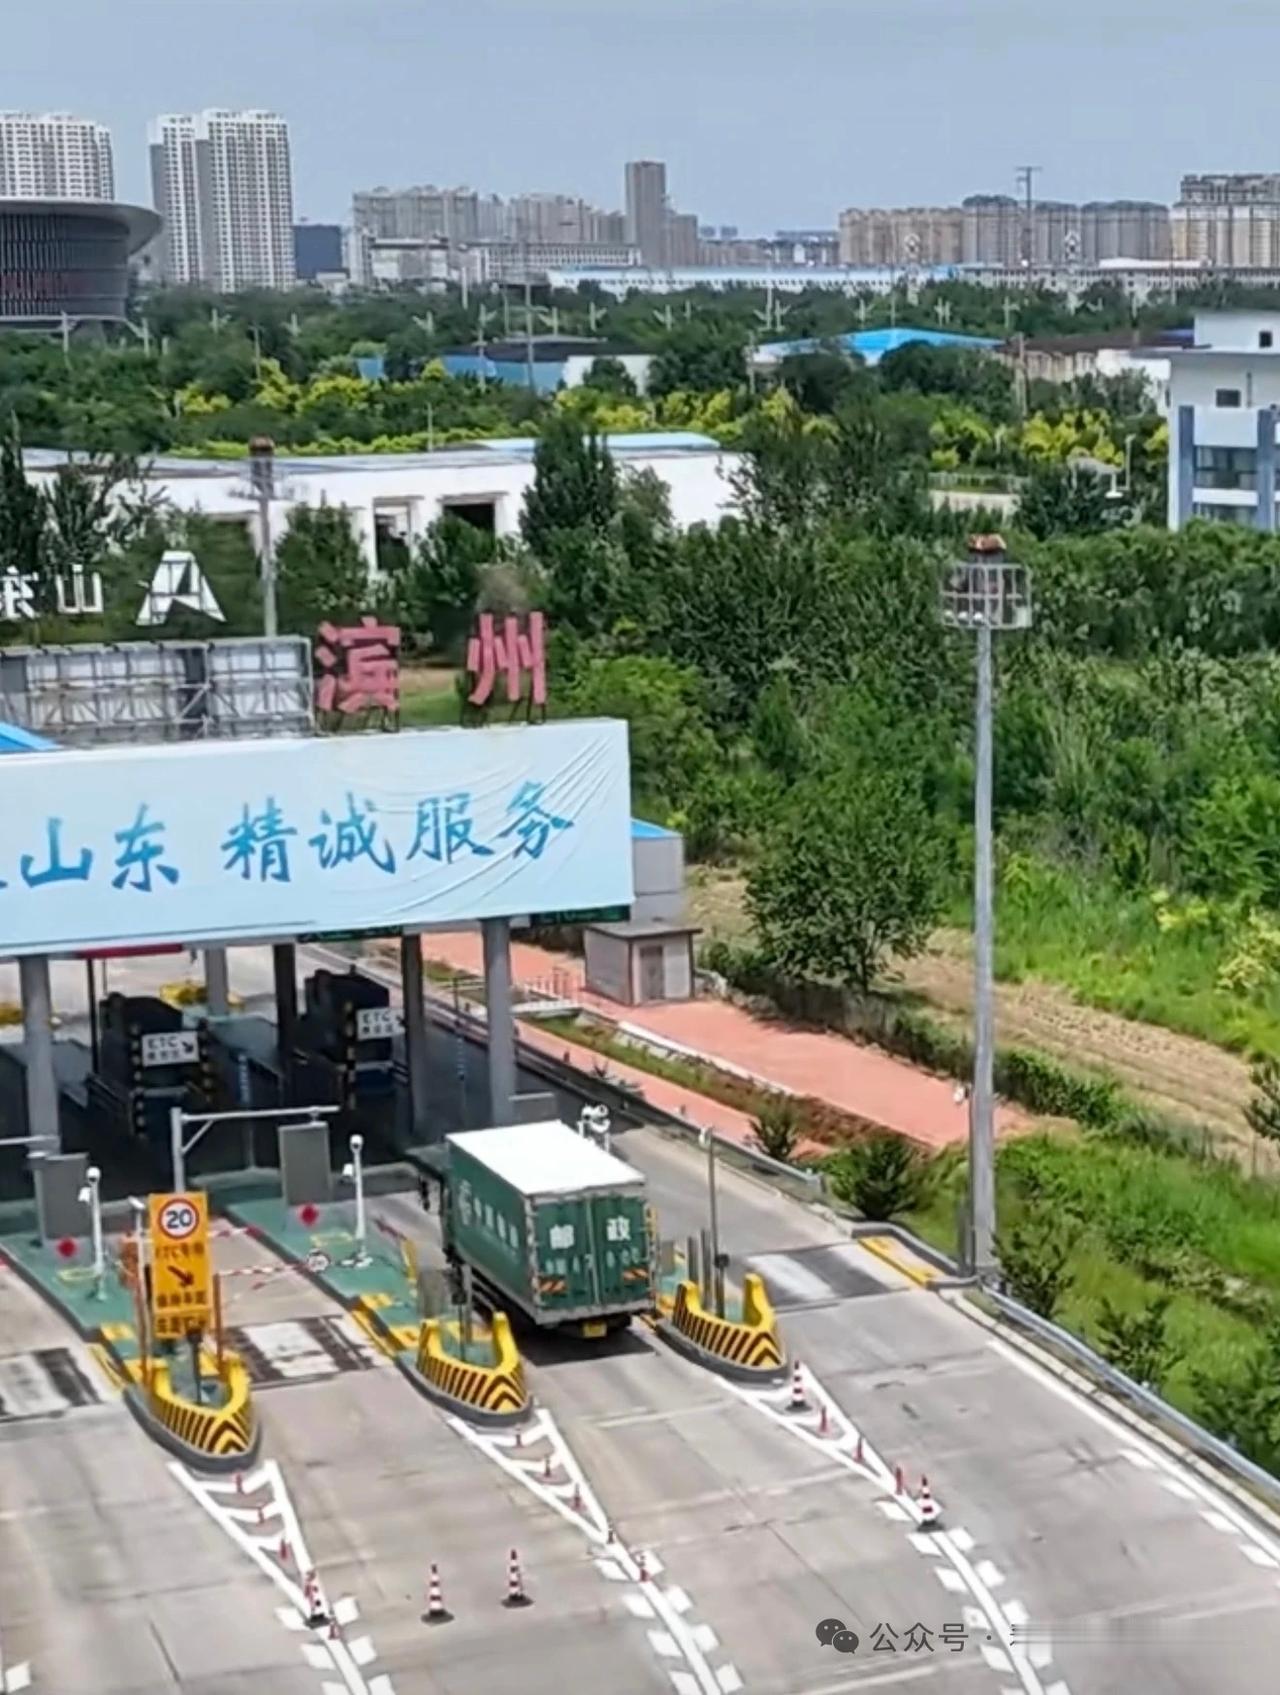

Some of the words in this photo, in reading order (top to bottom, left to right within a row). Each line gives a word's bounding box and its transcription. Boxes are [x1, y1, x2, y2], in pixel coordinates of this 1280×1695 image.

[315, 611, 547, 712] 滨州
[0, 803, 179, 892] 山东
[220, 782, 575, 882] 精诚服务
[148, 1036, 178, 1049] ETC
[166, 1208, 193, 1230] 20
